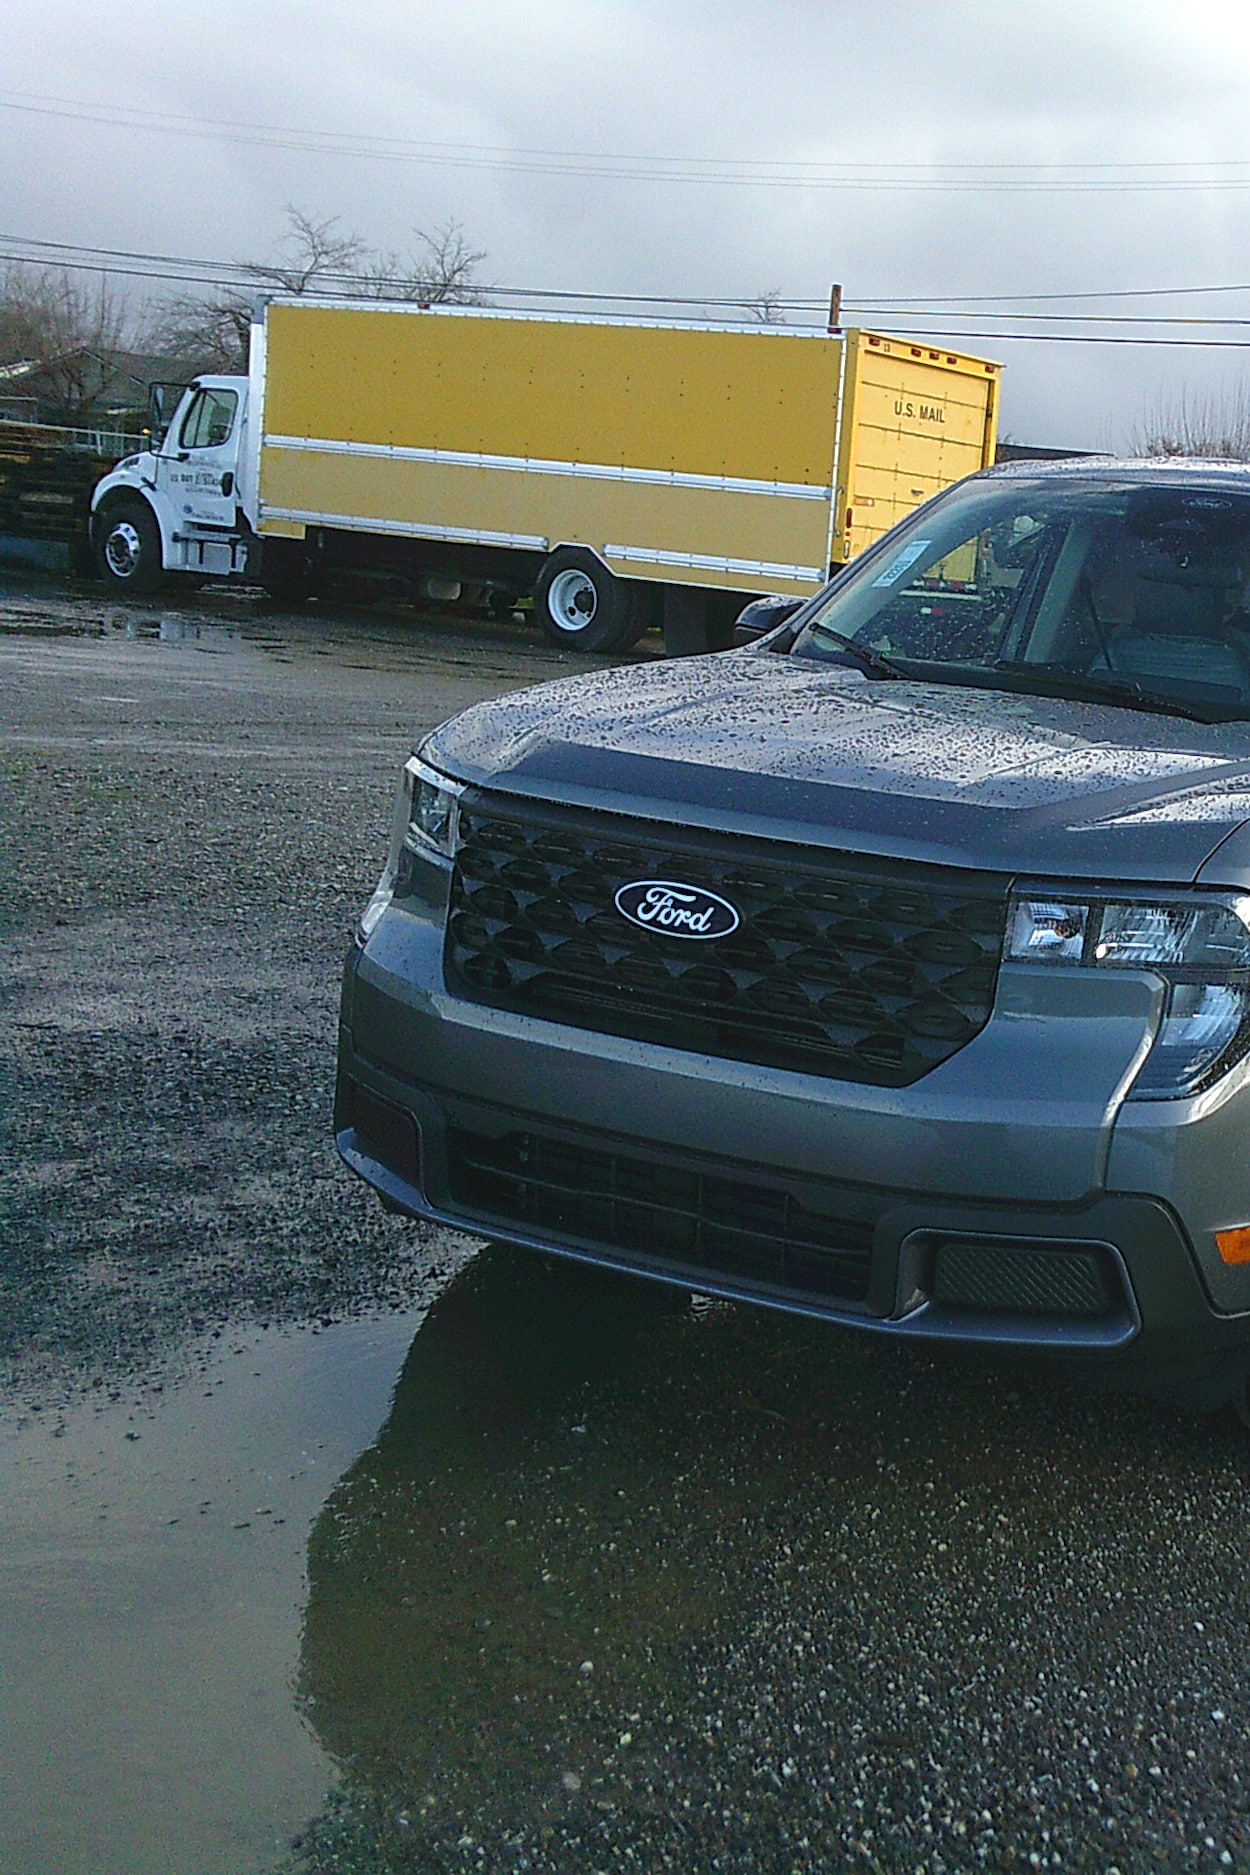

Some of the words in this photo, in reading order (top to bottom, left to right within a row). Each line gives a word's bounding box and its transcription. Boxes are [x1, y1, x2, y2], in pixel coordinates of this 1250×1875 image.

[894, 400, 916, 418] U.S.
[919, 404, 946, 424] MAIL
[636, 887, 715, 932] Ford
